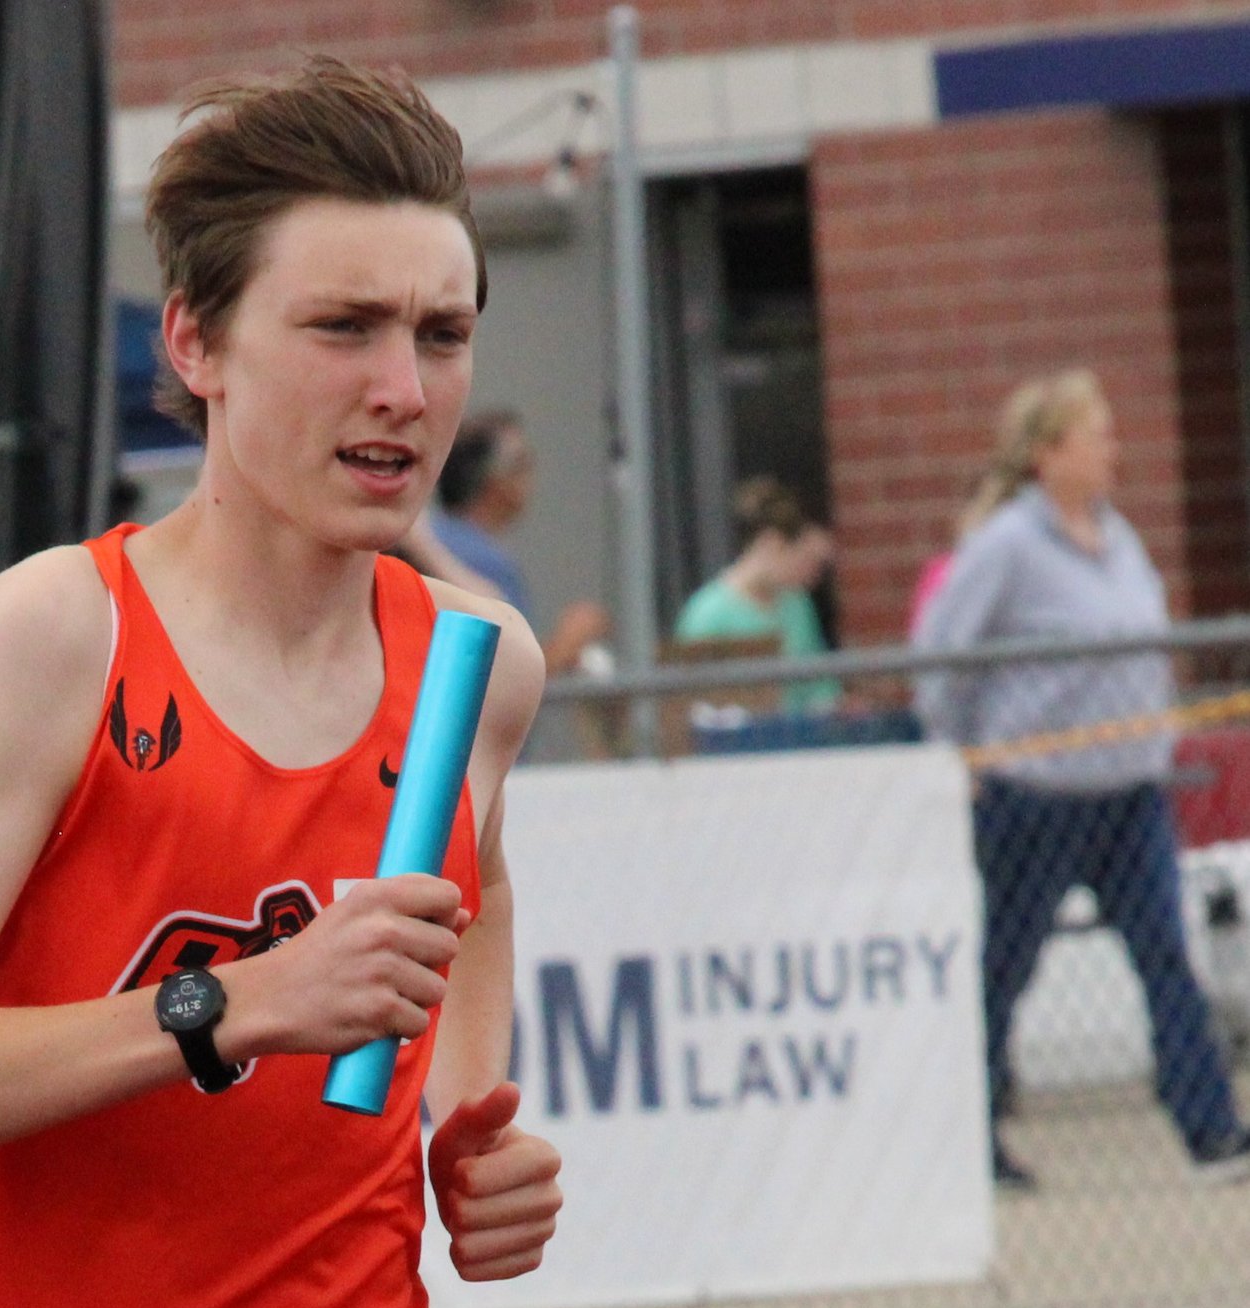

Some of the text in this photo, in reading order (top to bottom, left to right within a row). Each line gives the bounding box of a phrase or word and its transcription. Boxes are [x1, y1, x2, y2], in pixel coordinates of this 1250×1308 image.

[676, 932, 960, 1017] INJURY
[508, 957, 662, 1117] M
[683, 1032, 857, 1109] LAW
